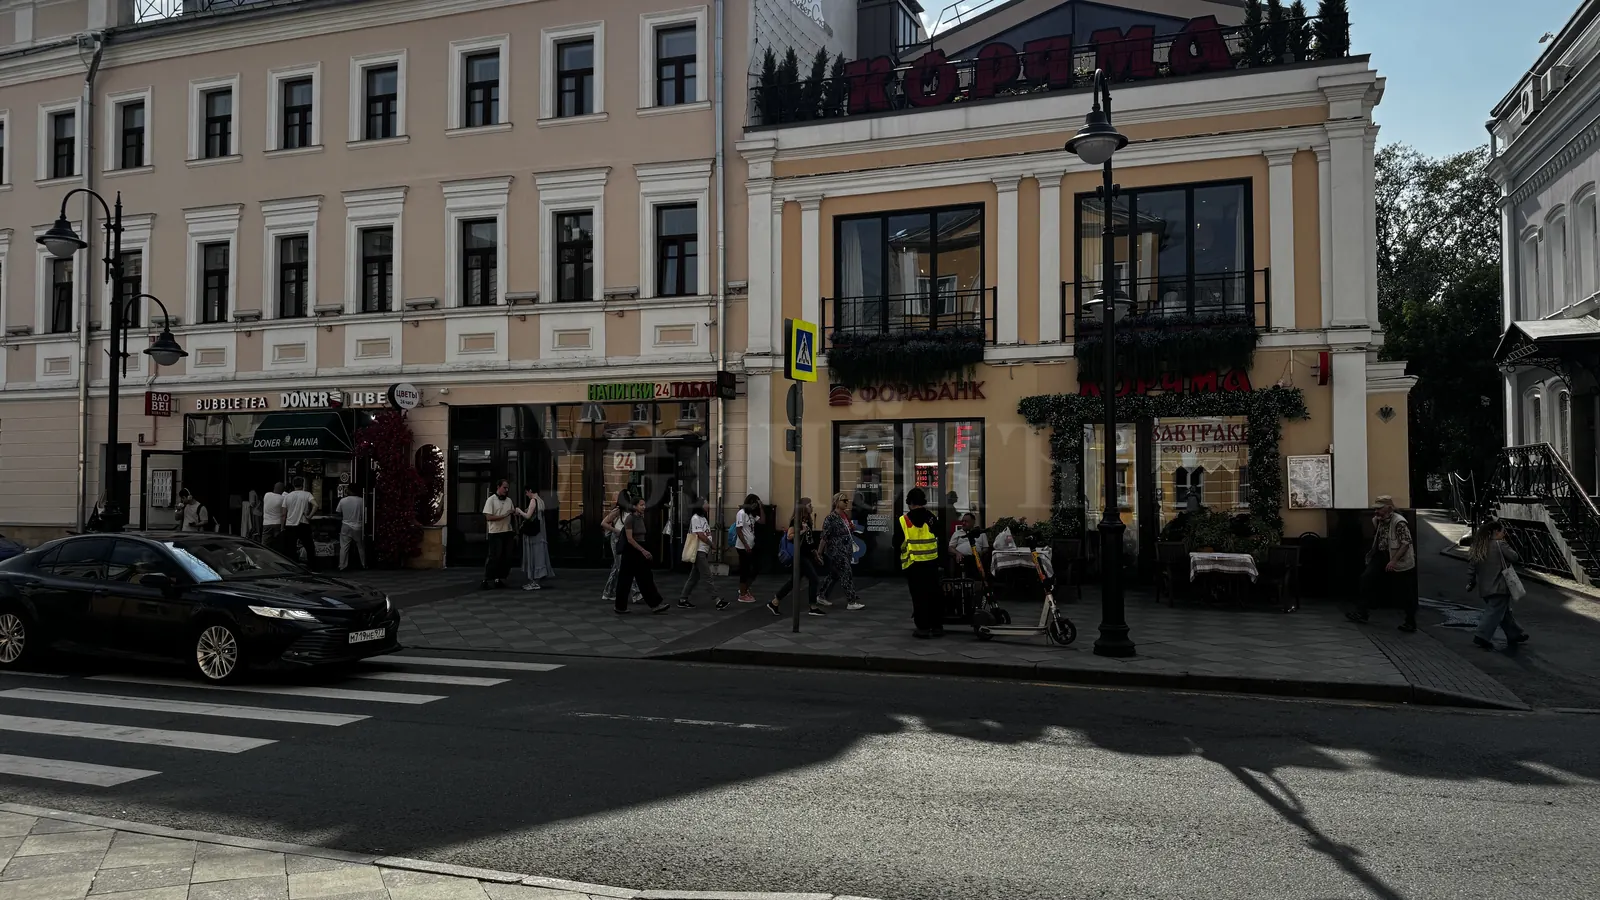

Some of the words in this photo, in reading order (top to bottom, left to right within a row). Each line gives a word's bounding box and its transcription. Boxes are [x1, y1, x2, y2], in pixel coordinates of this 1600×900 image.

[396, 389, 418, 399] ЦВЕТЫ
[587, 383, 654, 400] НАПИТКИ
[655, 384, 670, 397] 24
[151, 392, 170, 402] BAO
[353, 392, 387, 405] ЦВЕ
[151, 401, 169, 411] BEI
[196, 397, 241, 410] BUBBLE
[244, 397, 267, 409] TEA
[292, 437, 319, 447] MANIA
[1194, 446, 1209, 454] до
[1213, 444, 1240, 453] 12.00
[616, 452, 634, 469] 24
